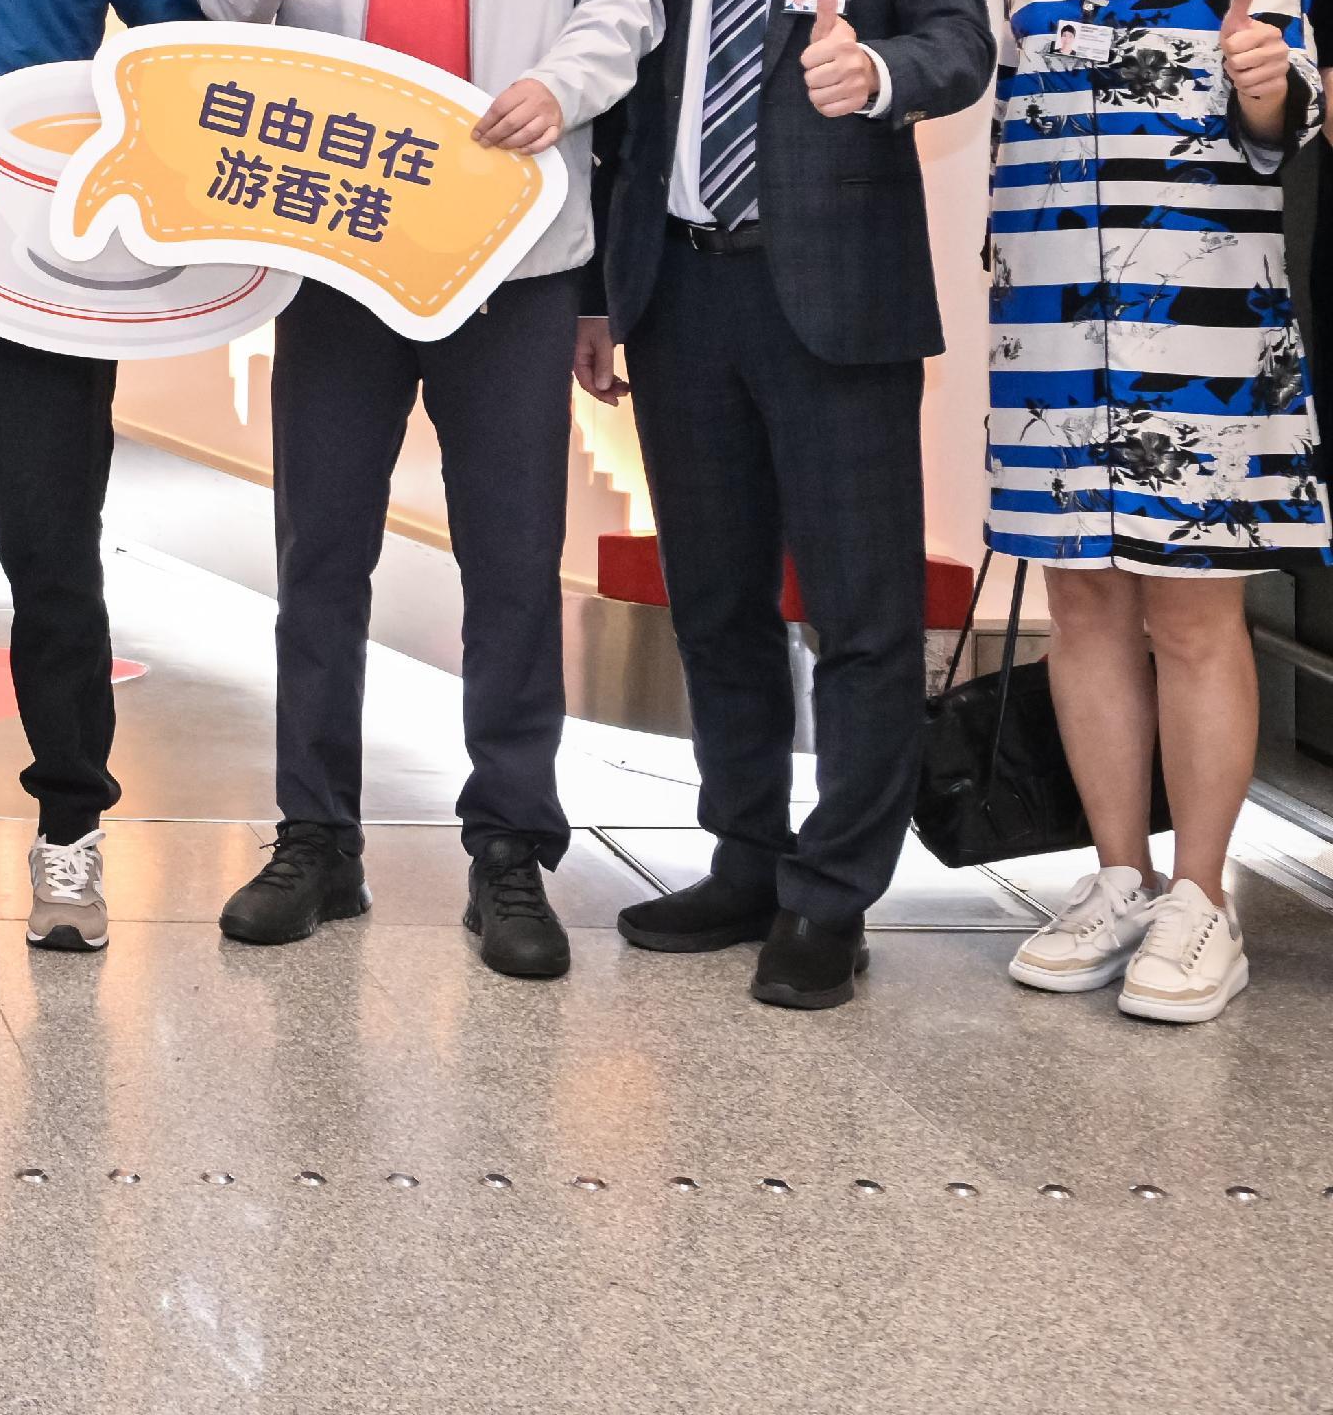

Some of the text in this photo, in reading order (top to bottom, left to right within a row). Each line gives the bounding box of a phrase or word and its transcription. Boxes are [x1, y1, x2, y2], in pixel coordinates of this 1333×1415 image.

[198, 81, 440, 186] 自由自在
[206, 146, 393, 243] 游香港
